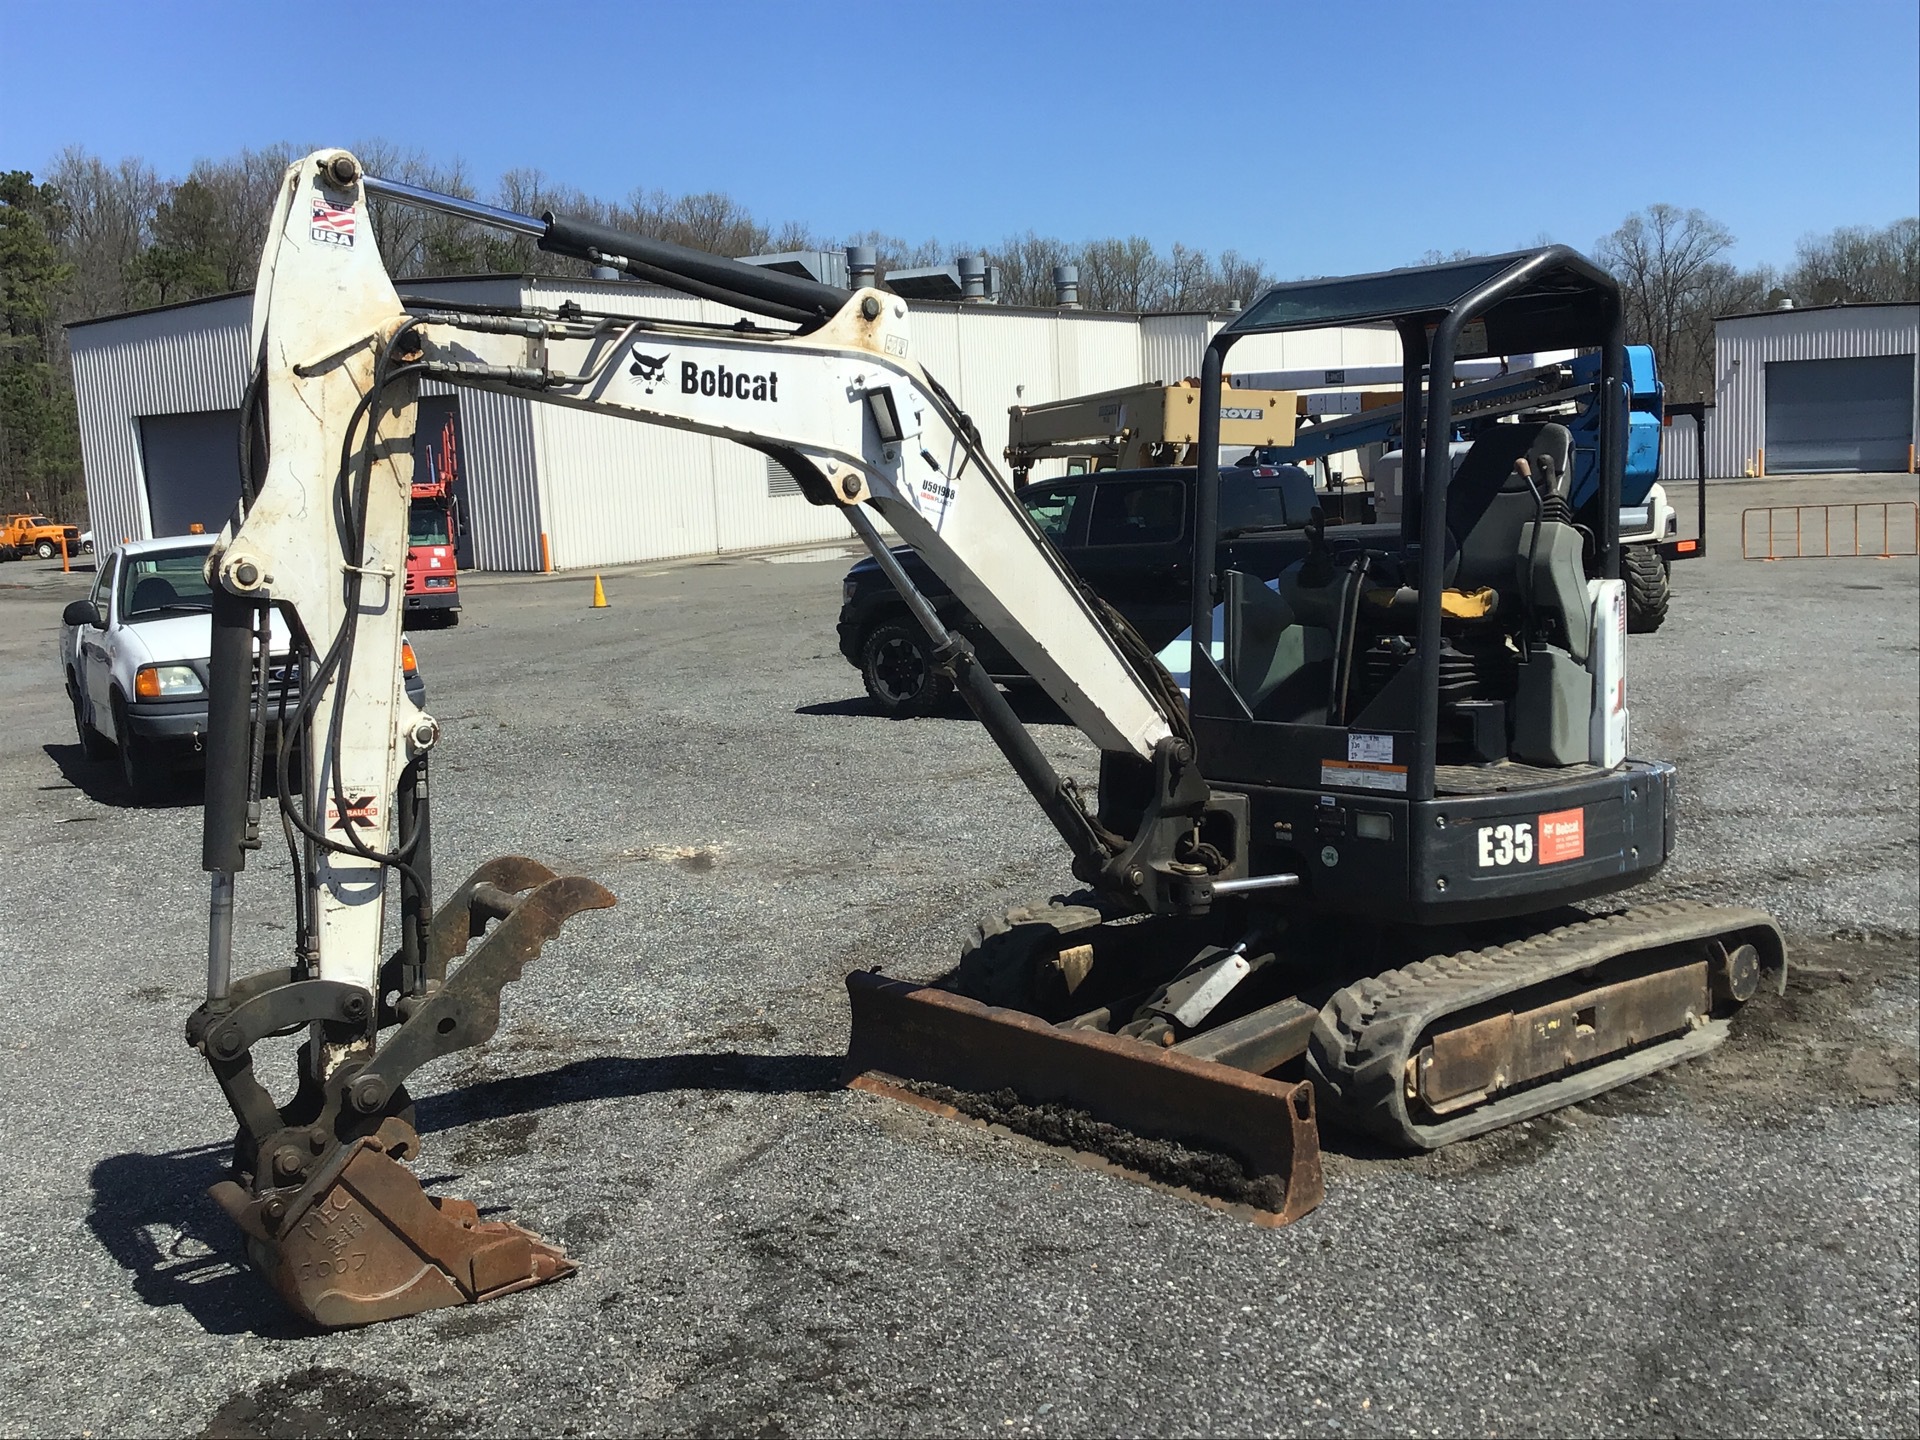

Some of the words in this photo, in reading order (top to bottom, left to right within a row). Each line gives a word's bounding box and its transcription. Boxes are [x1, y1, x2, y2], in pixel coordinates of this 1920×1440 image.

[313, 229, 352, 246] USA
[682, 361, 778, 402] Bobcat
[1220, 408, 1260, 419] ROVE
[922, 479, 956, 500] U591988
[330, 808, 377, 818] HYRAULIC
[1478, 823, 1533, 867] E35
